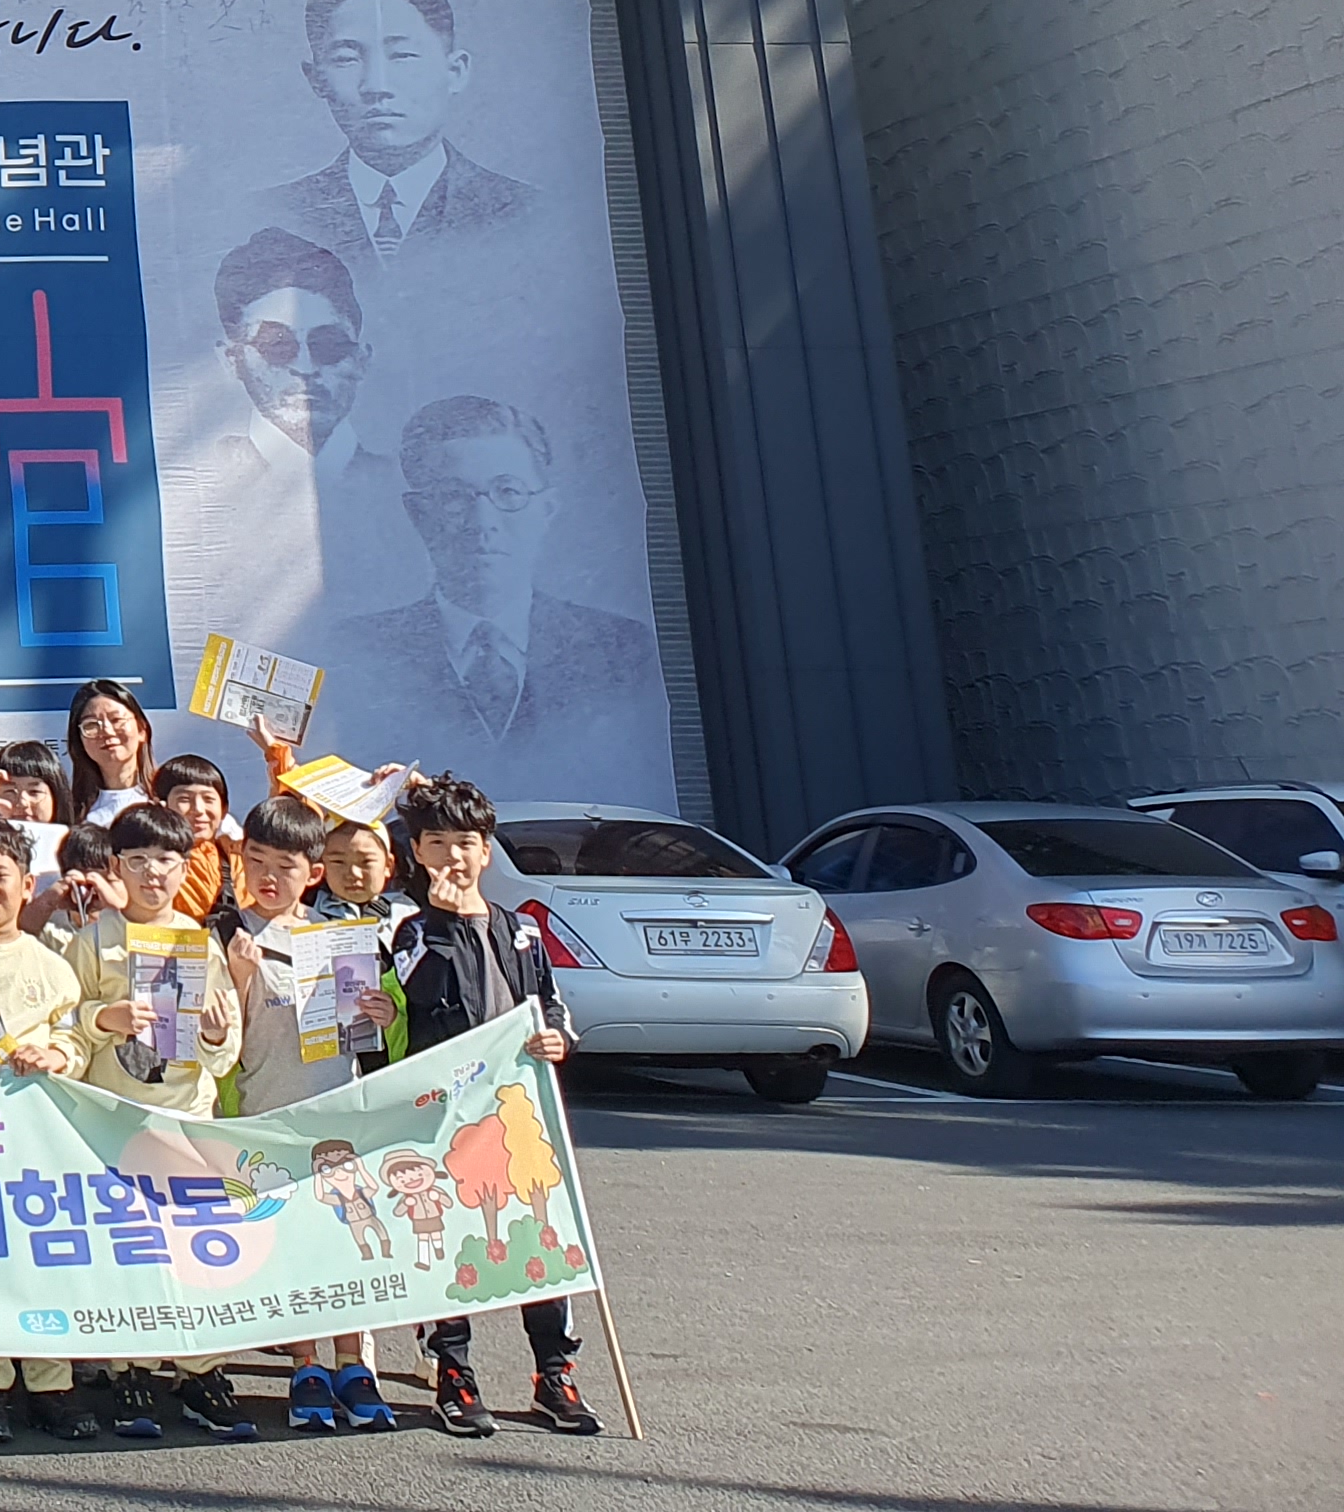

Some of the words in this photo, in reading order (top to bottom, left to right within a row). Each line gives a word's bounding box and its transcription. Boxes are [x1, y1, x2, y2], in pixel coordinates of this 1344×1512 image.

[33, 207, 108, 233] Hall
[657, 930, 692, 948] 61무
[699, 931, 746, 949] 2233
[1213, 933, 1259, 950] 7225
[264, 995, 291, 1008] now
[26, 1312, 64, 1332] 장소
[72, 1301, 258, 1335] 양산시립독립기념관
[260, 1293, 285, 1320] 및
[288, 1278, 367, 1316] 춘추공원
[369, 1272, 409, 1302] 일원
